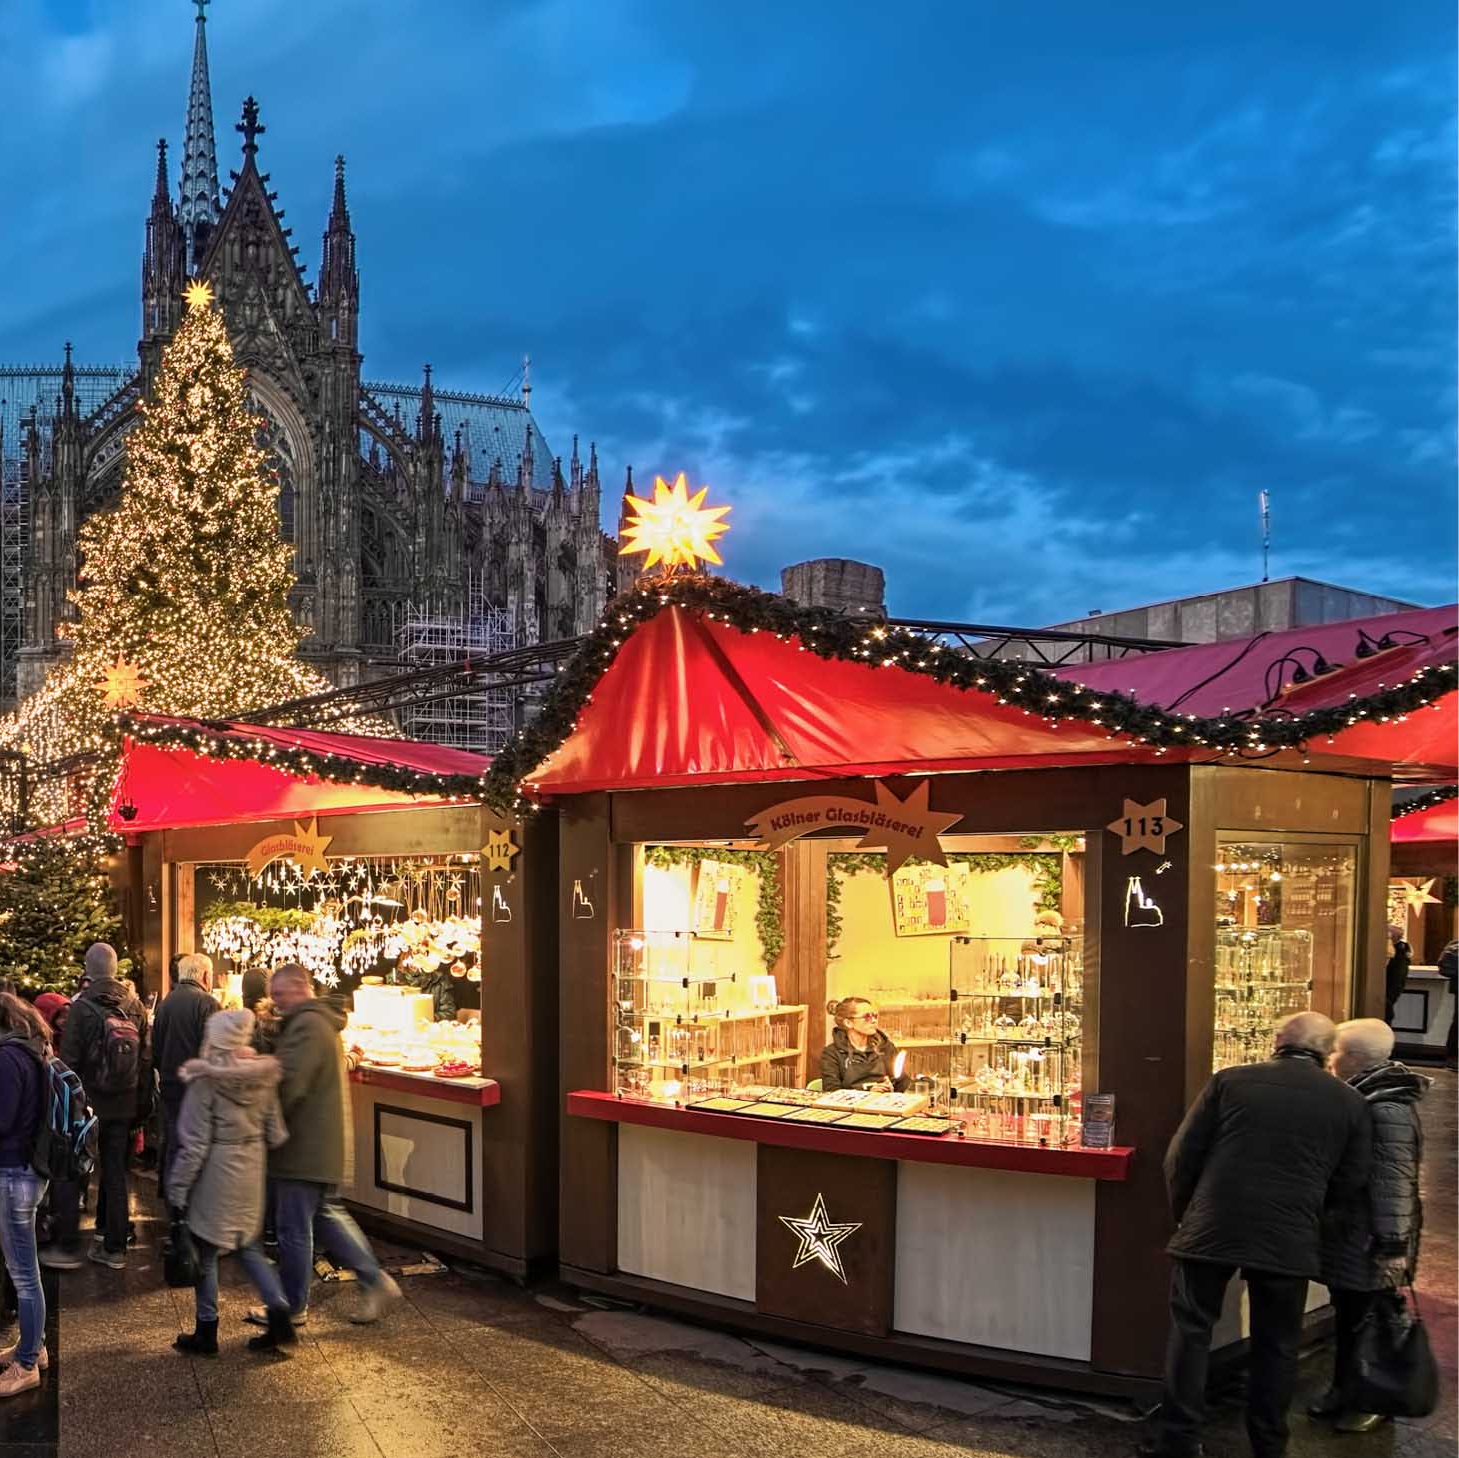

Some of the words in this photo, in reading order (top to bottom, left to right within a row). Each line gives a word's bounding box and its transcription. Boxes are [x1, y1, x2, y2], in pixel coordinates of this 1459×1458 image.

[771, 810, 820, 831] Kölner
[825, 807, 923, 838] Glasbläserei
[1123, 817, 1163, 836] 113
[489, 842, 510, 858] 112
